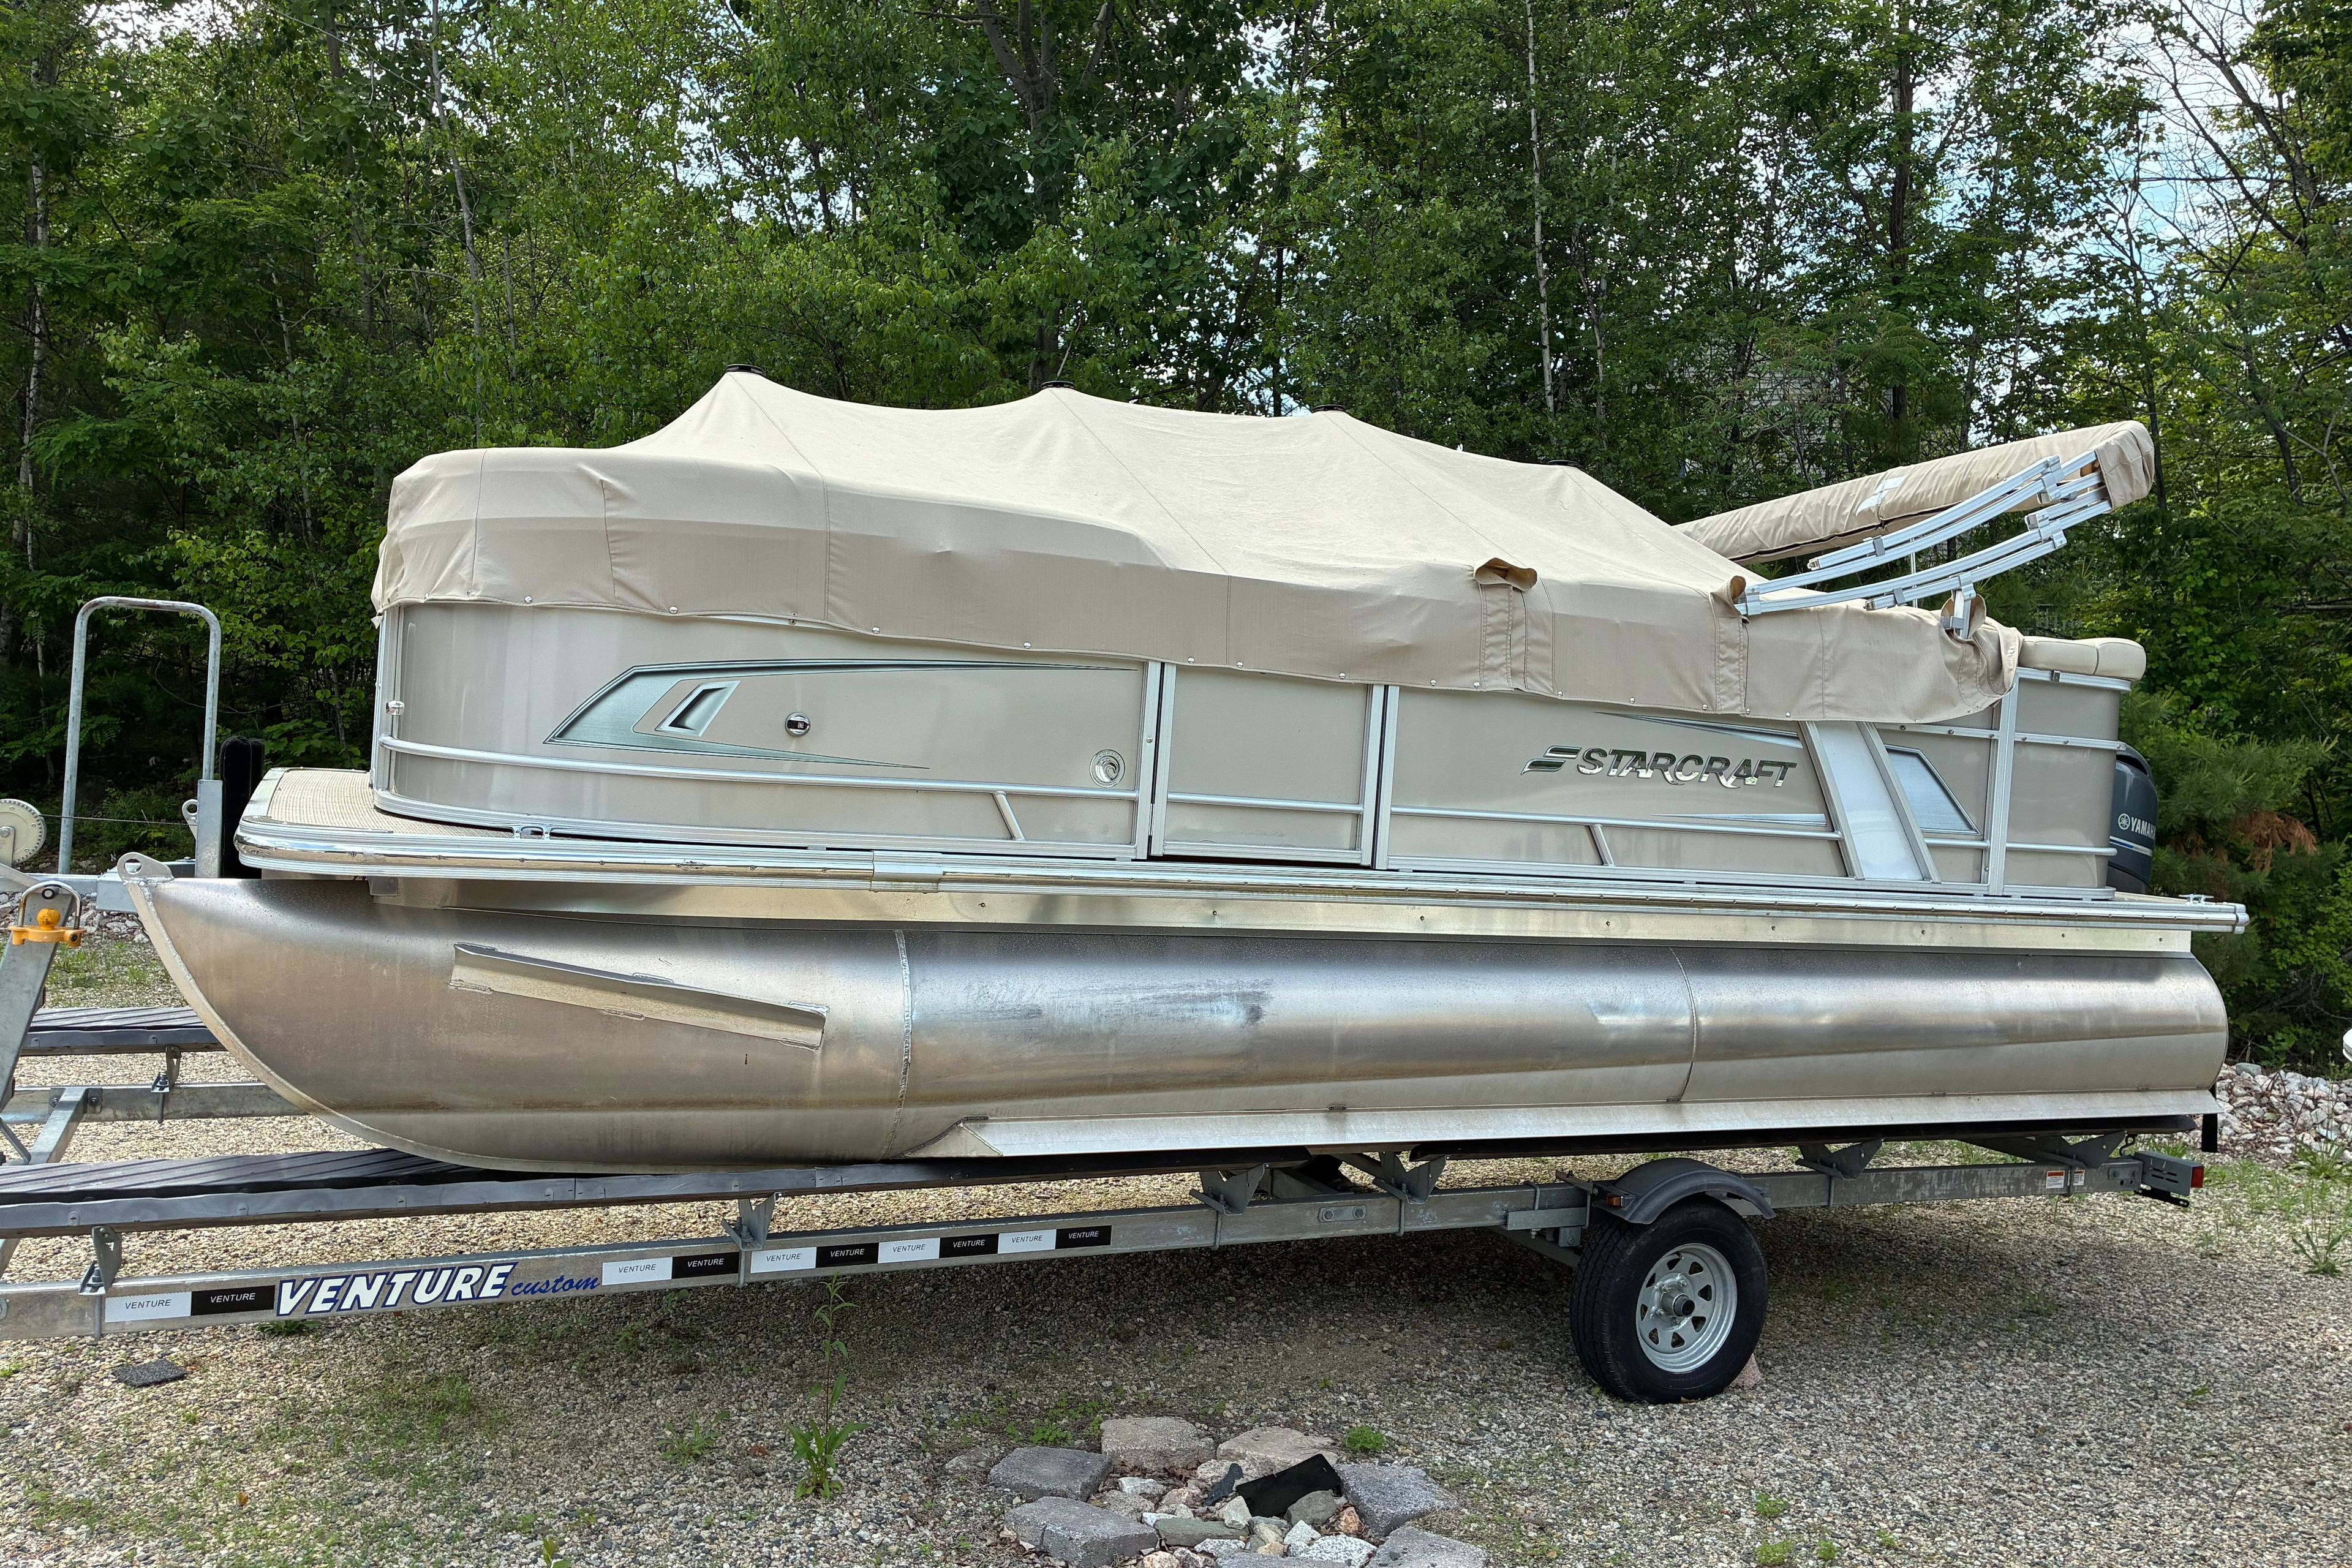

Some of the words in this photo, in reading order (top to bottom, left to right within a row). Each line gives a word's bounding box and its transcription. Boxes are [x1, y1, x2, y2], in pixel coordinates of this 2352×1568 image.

[1577, 748, 1798, 789] STARCRAFT
[953, 1239, 986, 1248] VENTURE
[830, 1248, 865, 1257] VENTURE
[892, 1244, 926, 1253] VENTURE
[766, 1253, 802, 1262] VENTURE
[687, 1258, 725, 1267] VENTURE
[619, 1264, 656, 1273] VENTURE
[276, 1261, 519, 1316] VENTURE
[511, 1275, 600, 1296] custom
[210, 1293, 256, 1303] VENTURE
[125, 1299, 172, 1309] VENTURE
